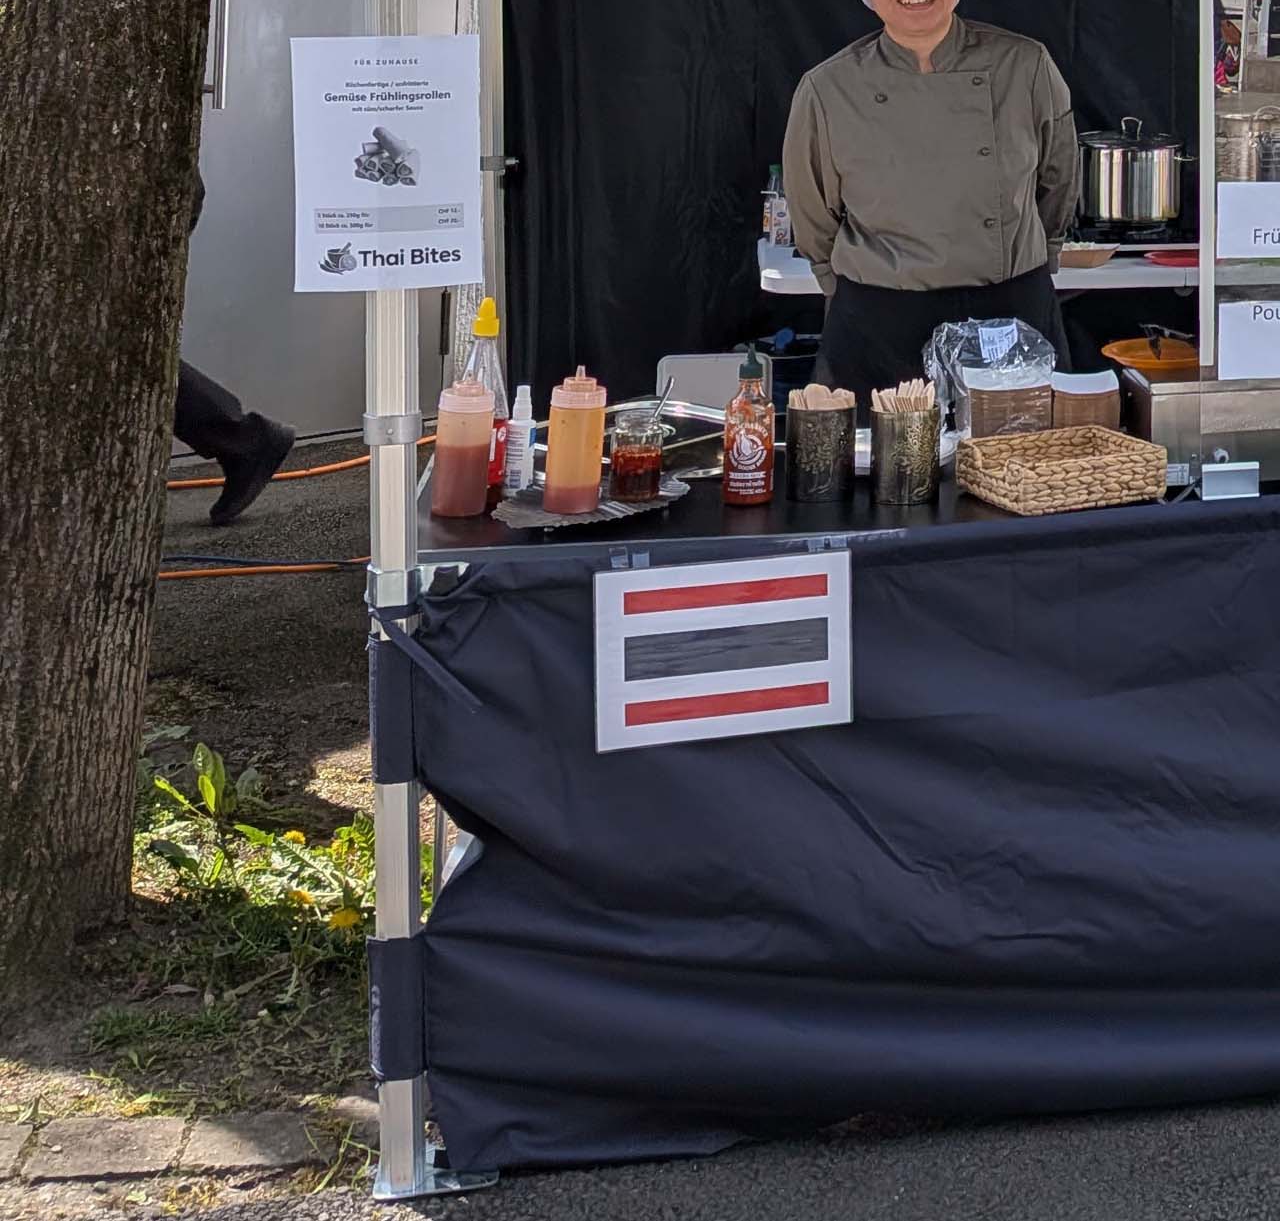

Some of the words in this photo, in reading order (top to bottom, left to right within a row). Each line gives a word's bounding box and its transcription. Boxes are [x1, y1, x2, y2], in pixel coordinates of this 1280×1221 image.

[354, 58, 372, 66] FÜR
[375, 58, 419, 66] ZUHAUSE
[324, 92, 367, 102] Gemüse
[369, 90, 452, 102] Frühlingsrollen
[358, 248, 404, 267] Thai
[410, 246, 461, 265] Bites
